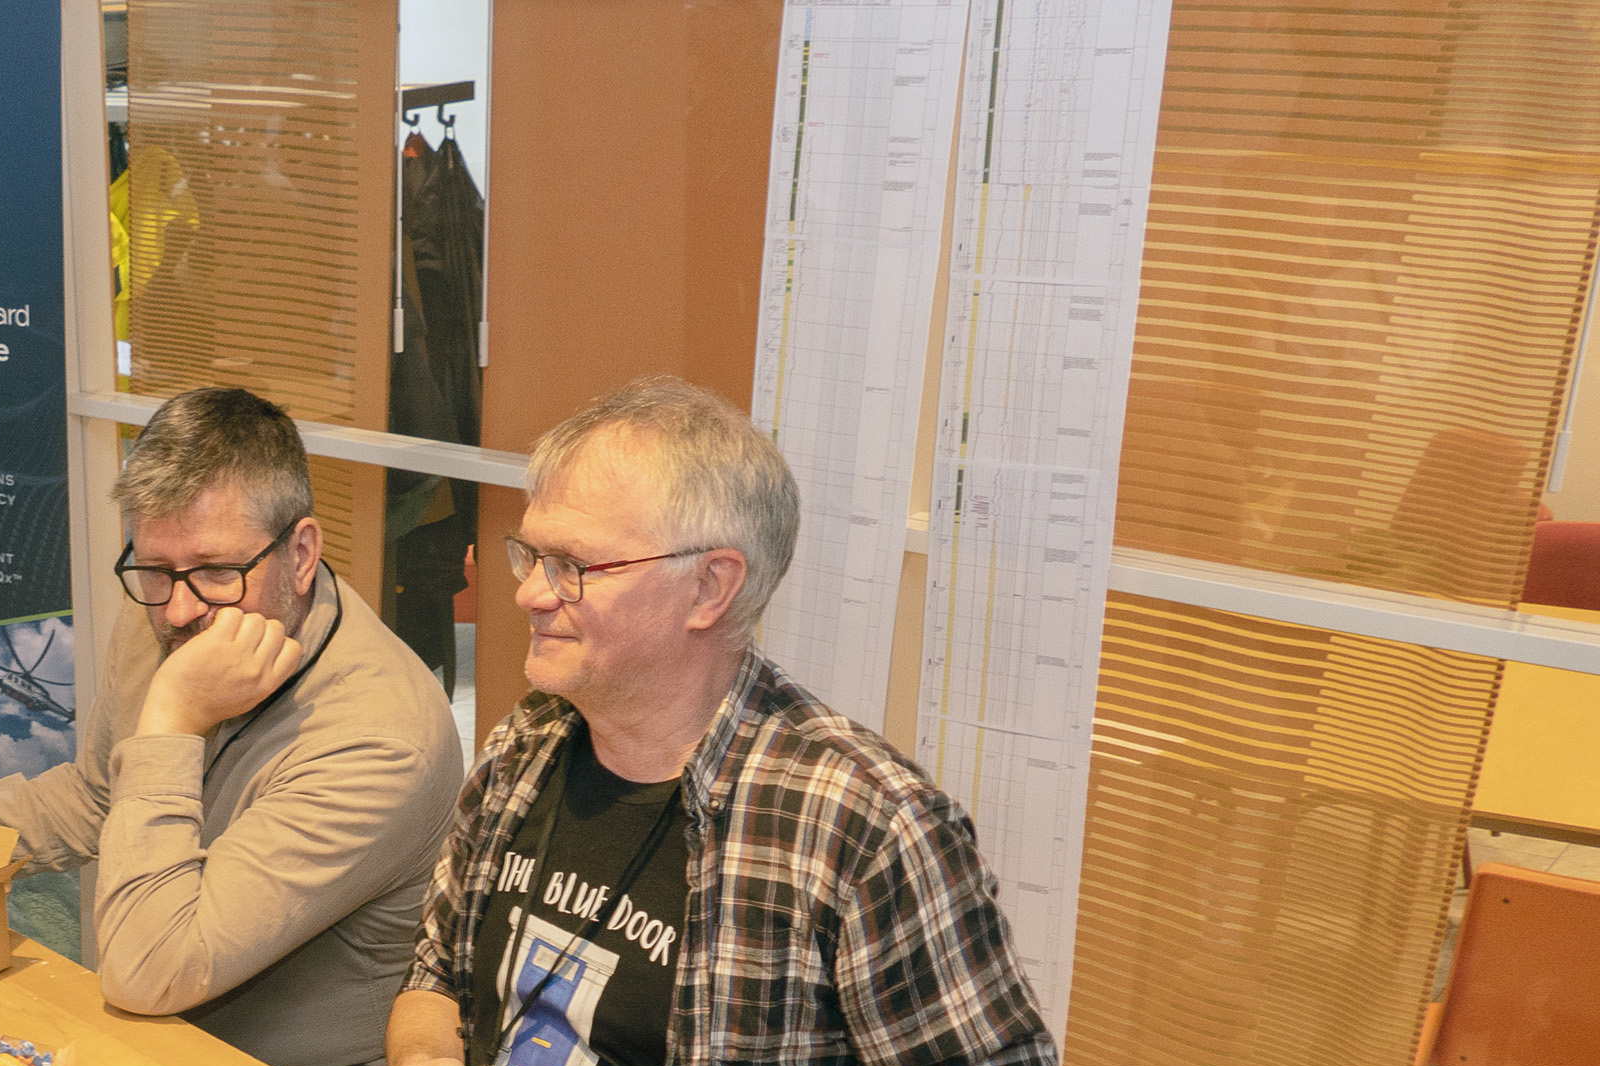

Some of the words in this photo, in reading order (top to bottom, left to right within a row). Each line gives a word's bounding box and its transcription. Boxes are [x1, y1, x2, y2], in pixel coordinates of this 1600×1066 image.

[497, 851, 536, 893] THE
[543, 871, 611, 923] BLUE
[607, 893, 677, 967] DOOR
